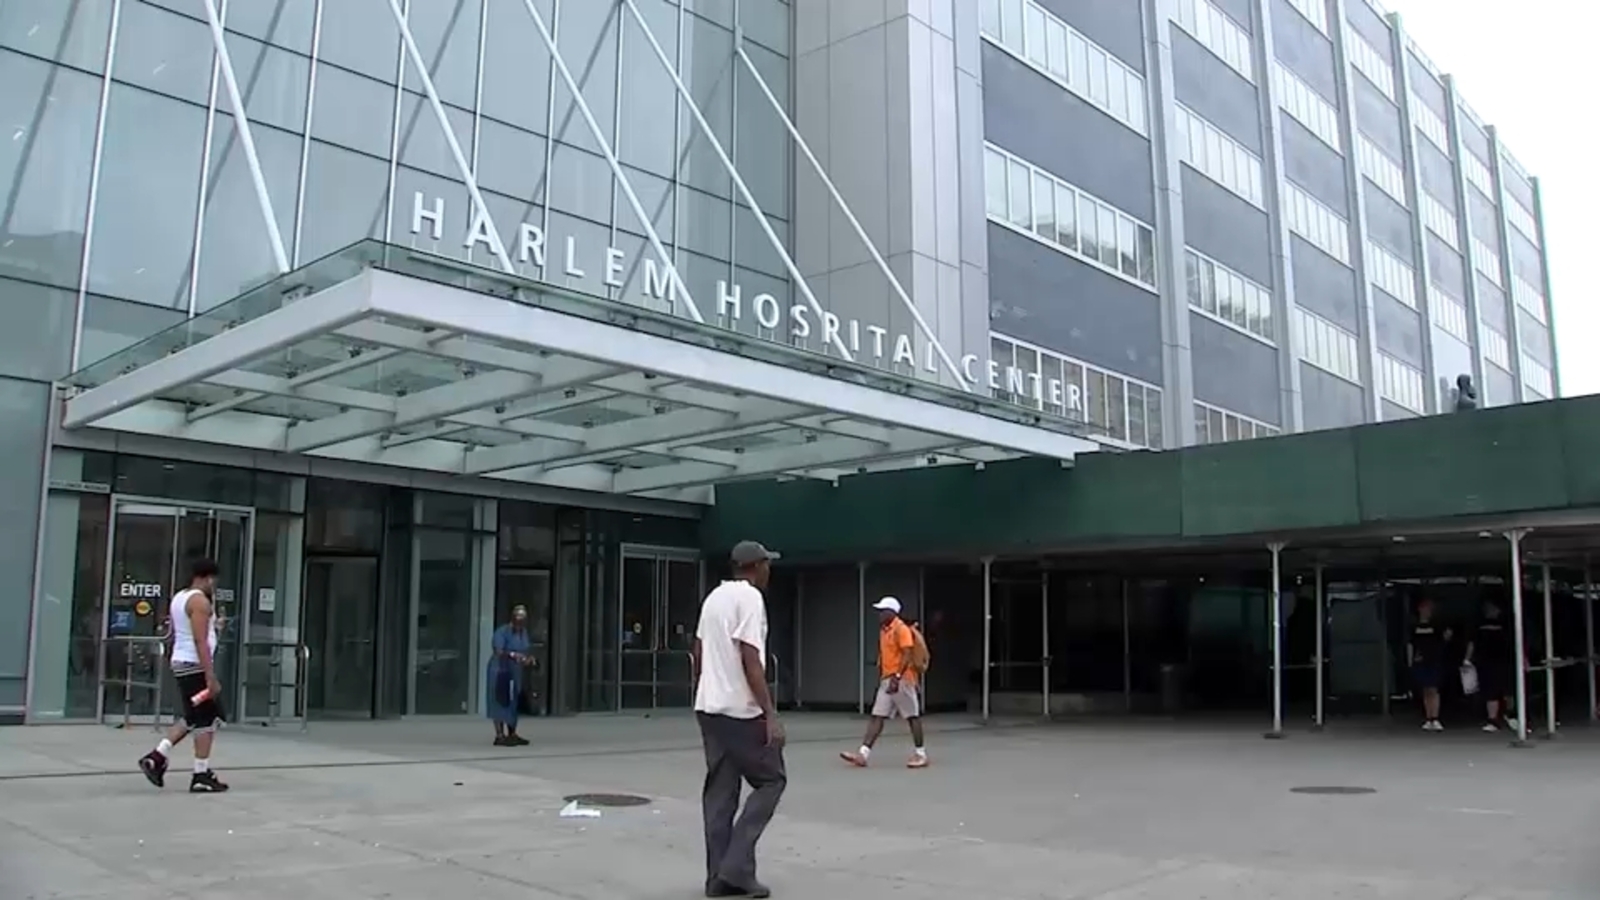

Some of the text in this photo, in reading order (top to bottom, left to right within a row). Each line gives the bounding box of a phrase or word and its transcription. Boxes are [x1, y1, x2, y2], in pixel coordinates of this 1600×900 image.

[411, 191, 1082, 412] HARLEM HOSPITAL CENTER
[120, 583, 161, 598] ENTER
